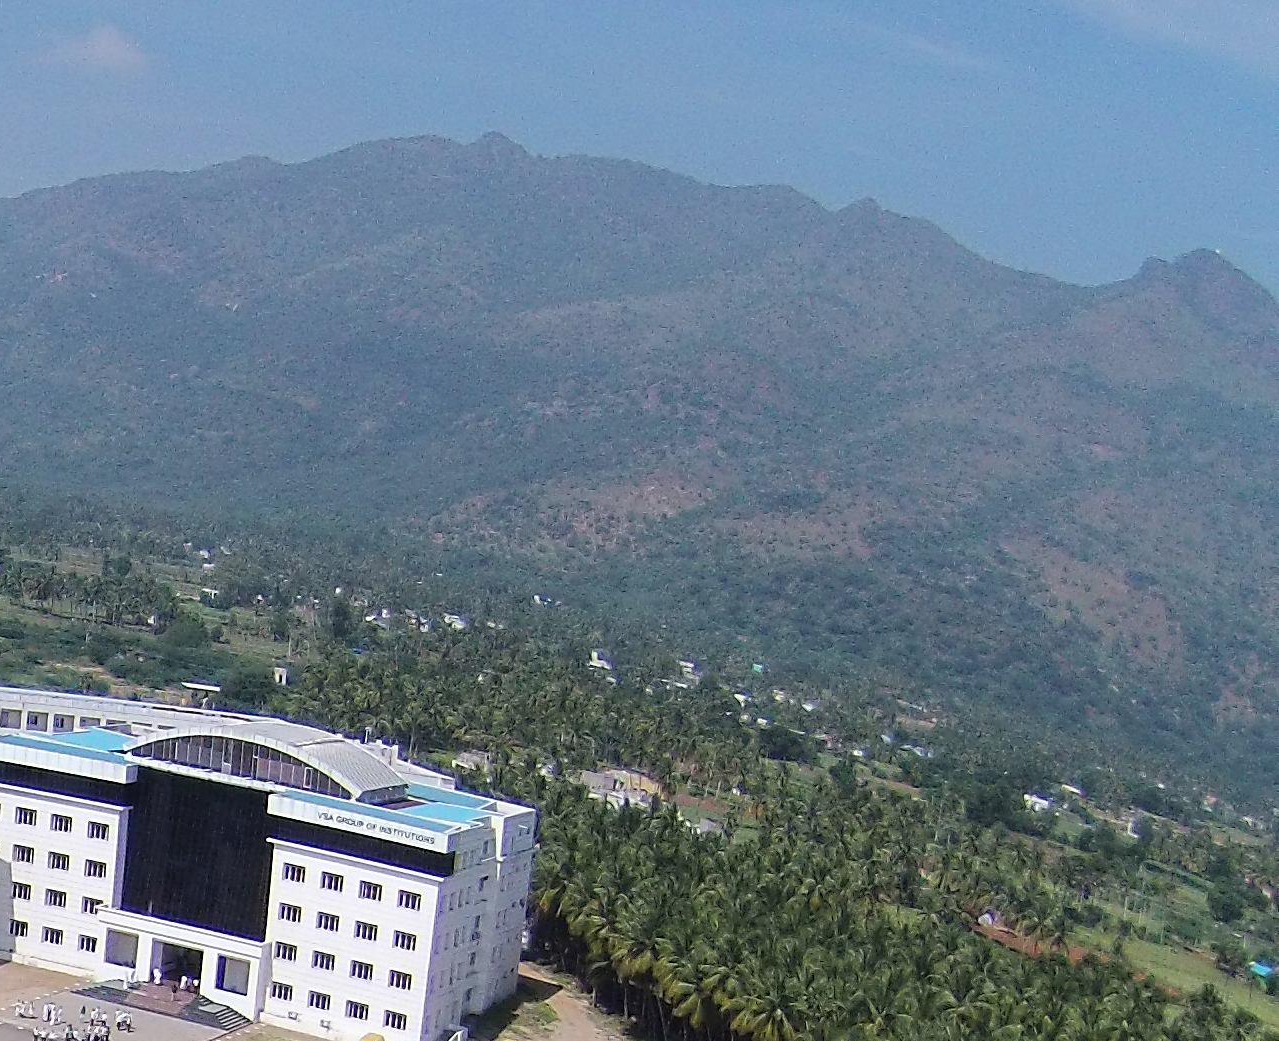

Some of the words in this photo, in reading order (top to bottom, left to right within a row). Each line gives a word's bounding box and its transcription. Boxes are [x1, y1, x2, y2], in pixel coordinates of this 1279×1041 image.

[317, 811, 334, 821] VSA
[336, 815, 364, 828] GROUP
[366, 822, 378, 831] OF
[379, 826, 435, 845] INSTITUTIONS
